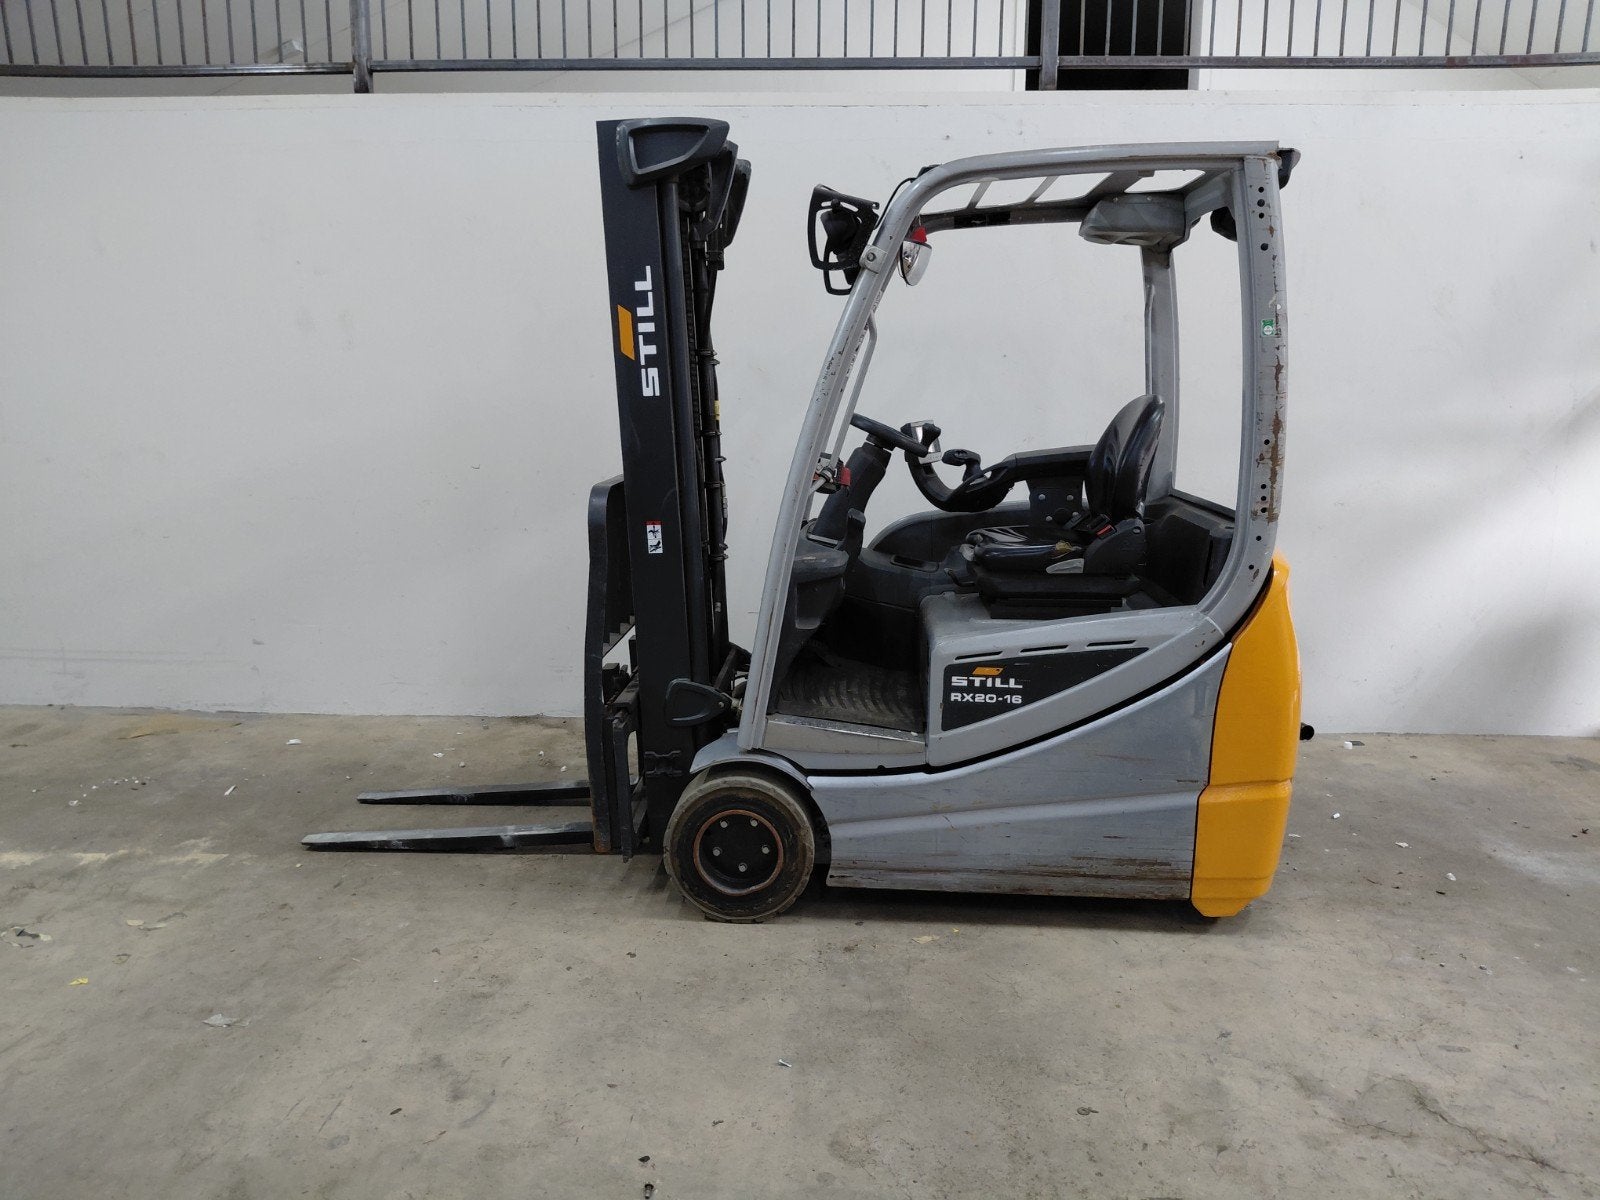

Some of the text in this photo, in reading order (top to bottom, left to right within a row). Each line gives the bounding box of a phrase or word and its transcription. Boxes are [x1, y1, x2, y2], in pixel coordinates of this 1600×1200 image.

[634, 265, 660, 397] STILL
[951, 676, 1023, 688] STILL
[950, 692, 1022, 704] RX20-16
